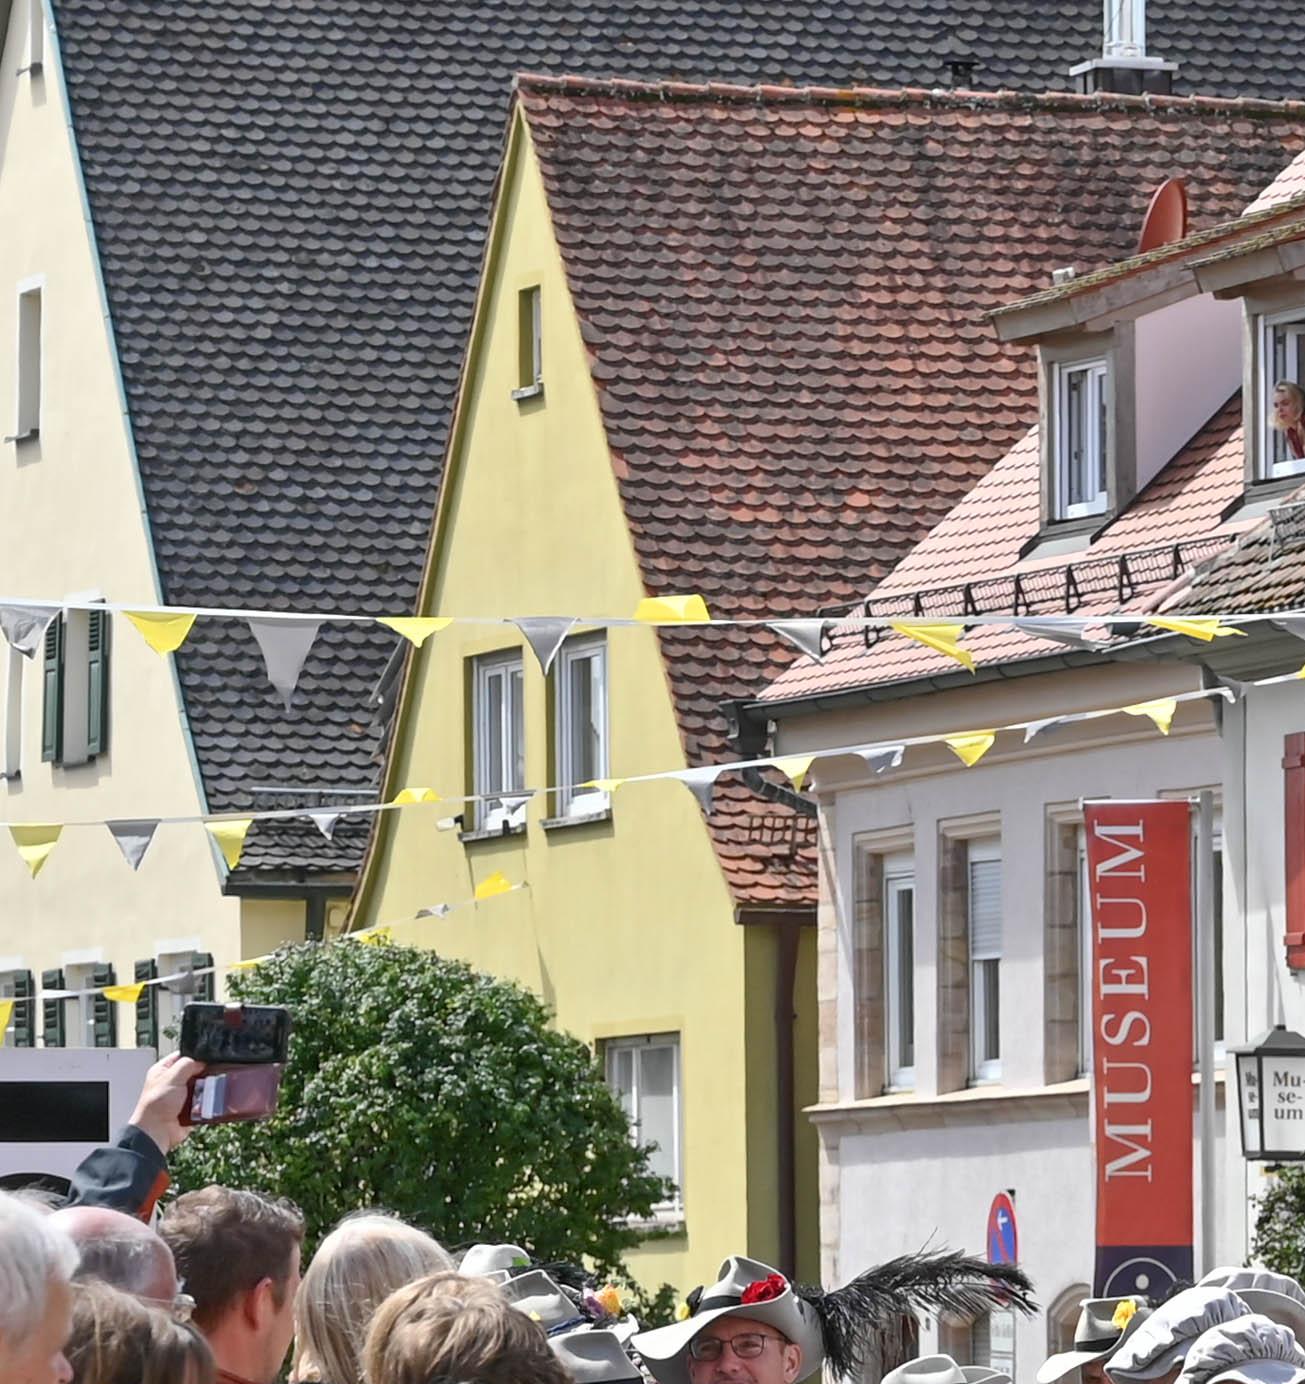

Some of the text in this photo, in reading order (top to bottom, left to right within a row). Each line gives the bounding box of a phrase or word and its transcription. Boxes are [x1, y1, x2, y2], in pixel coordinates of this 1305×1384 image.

[1094, 819, 1152, 1182] MUSEUM
[1277, 1091, 1303, 1104] se-
[1274, 1108, 1303, 1120] um
